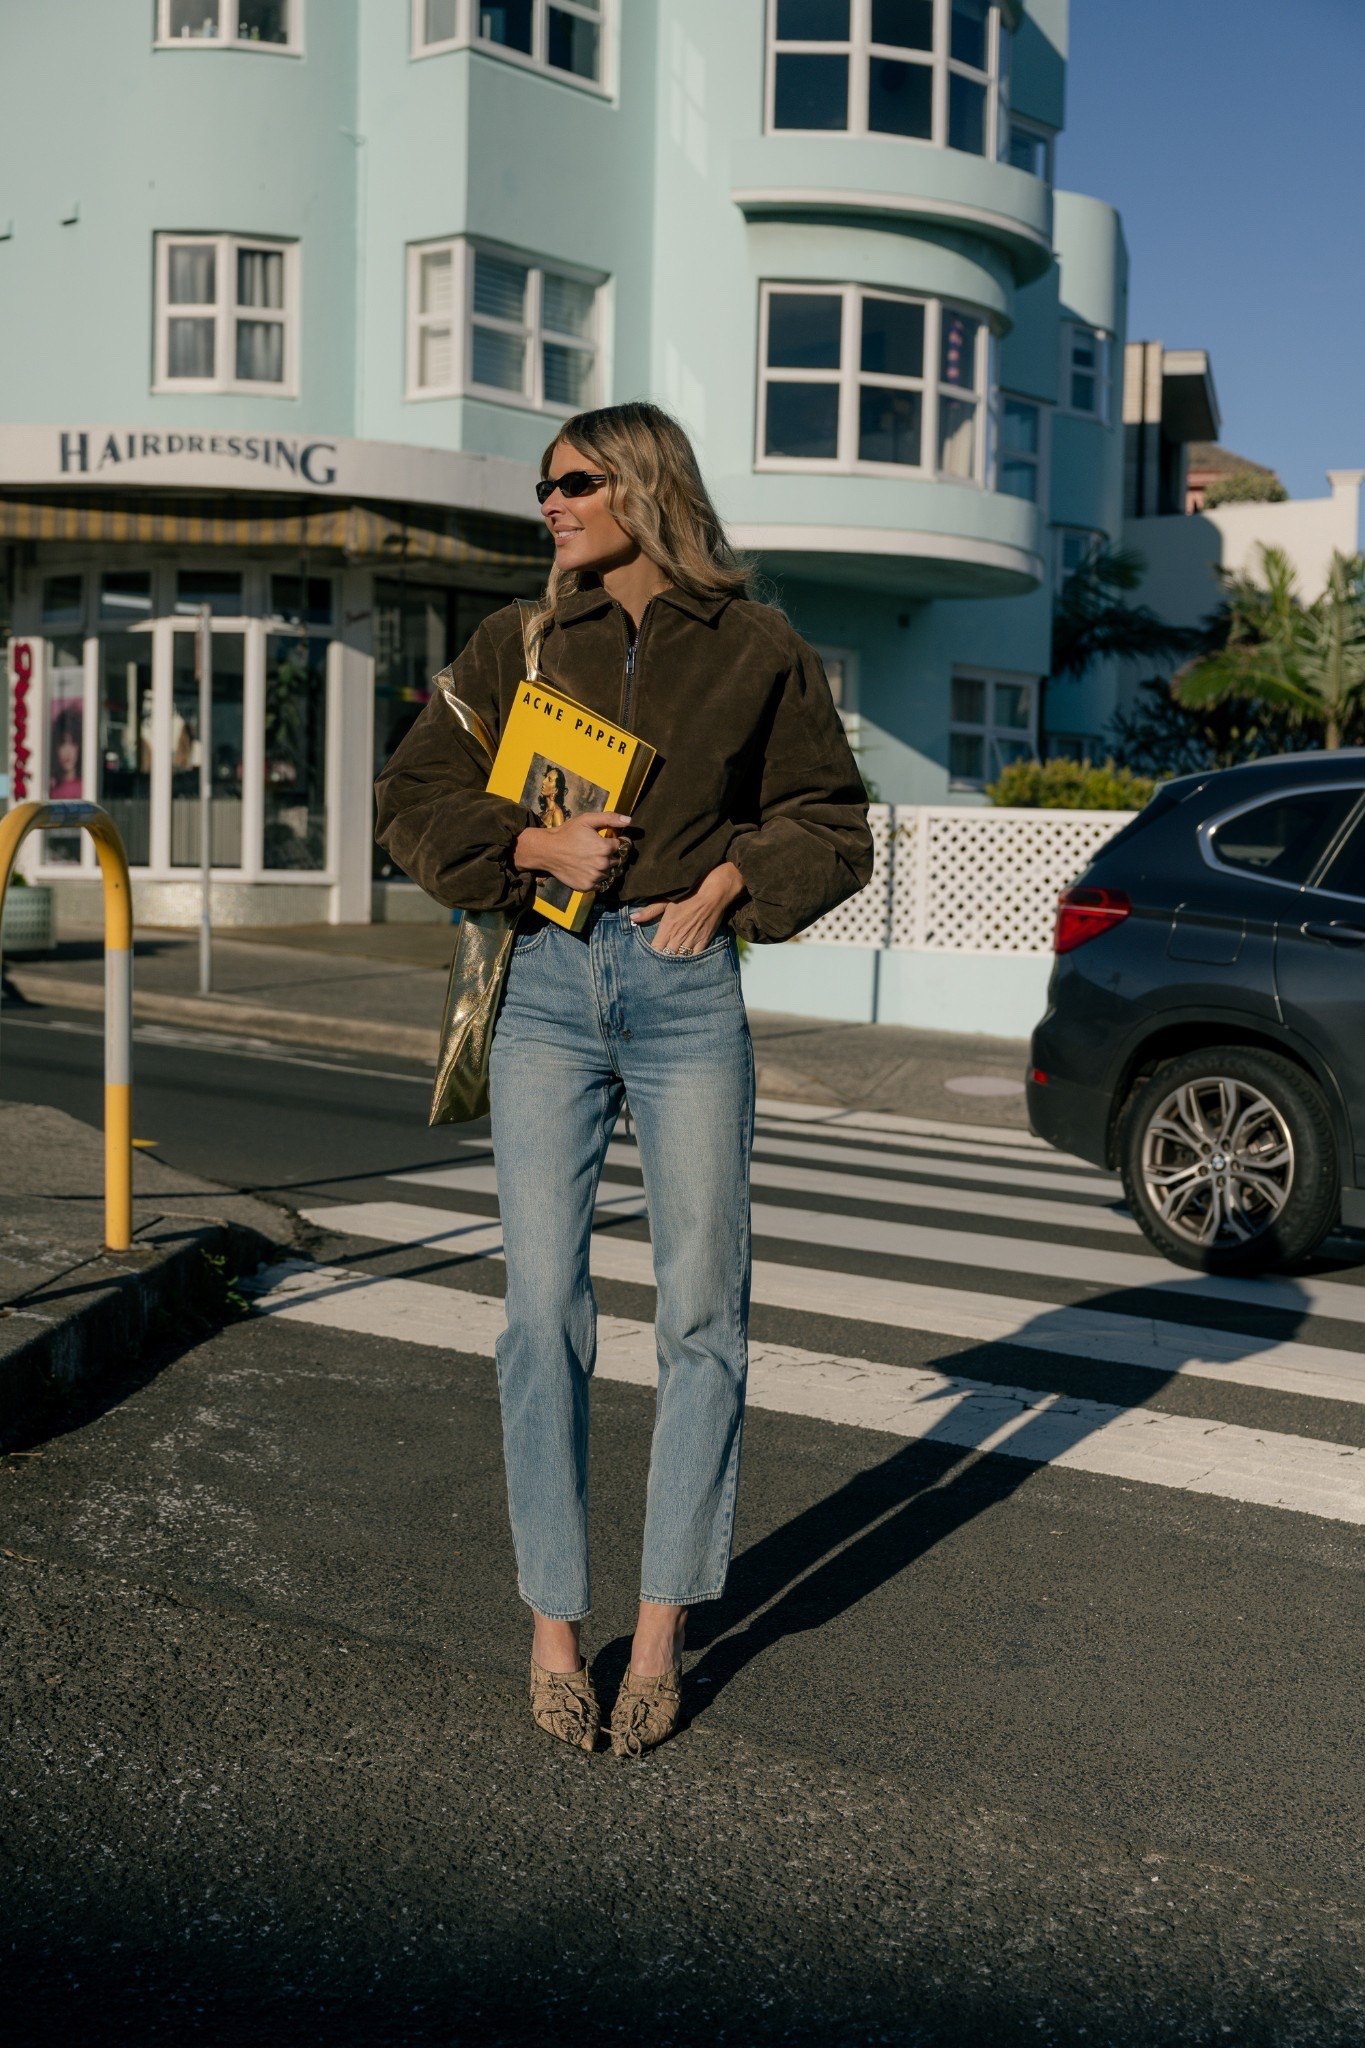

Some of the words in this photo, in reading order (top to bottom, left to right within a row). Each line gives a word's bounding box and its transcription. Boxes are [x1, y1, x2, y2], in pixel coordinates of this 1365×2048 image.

[60, 432, 337, 485] HAIRDRESSING
[523, 692, 563, 721] ACNE
[575, 718, 627, 755] PAPER
